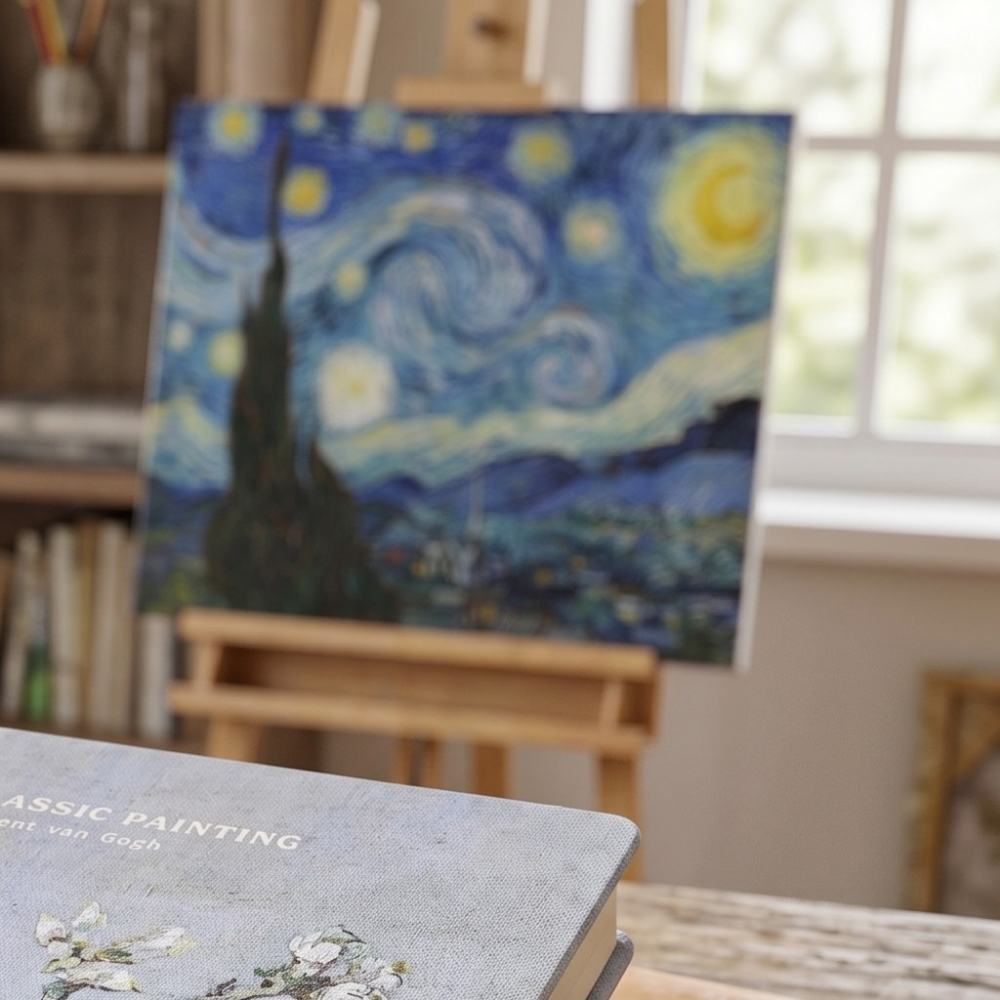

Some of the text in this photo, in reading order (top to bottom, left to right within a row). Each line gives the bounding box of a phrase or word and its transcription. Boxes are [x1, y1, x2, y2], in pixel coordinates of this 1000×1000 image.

[48, 825, 89, 840] van
[100, 832, 162, 852] Gogh
[121, 811, 302, 850] PAINTING
